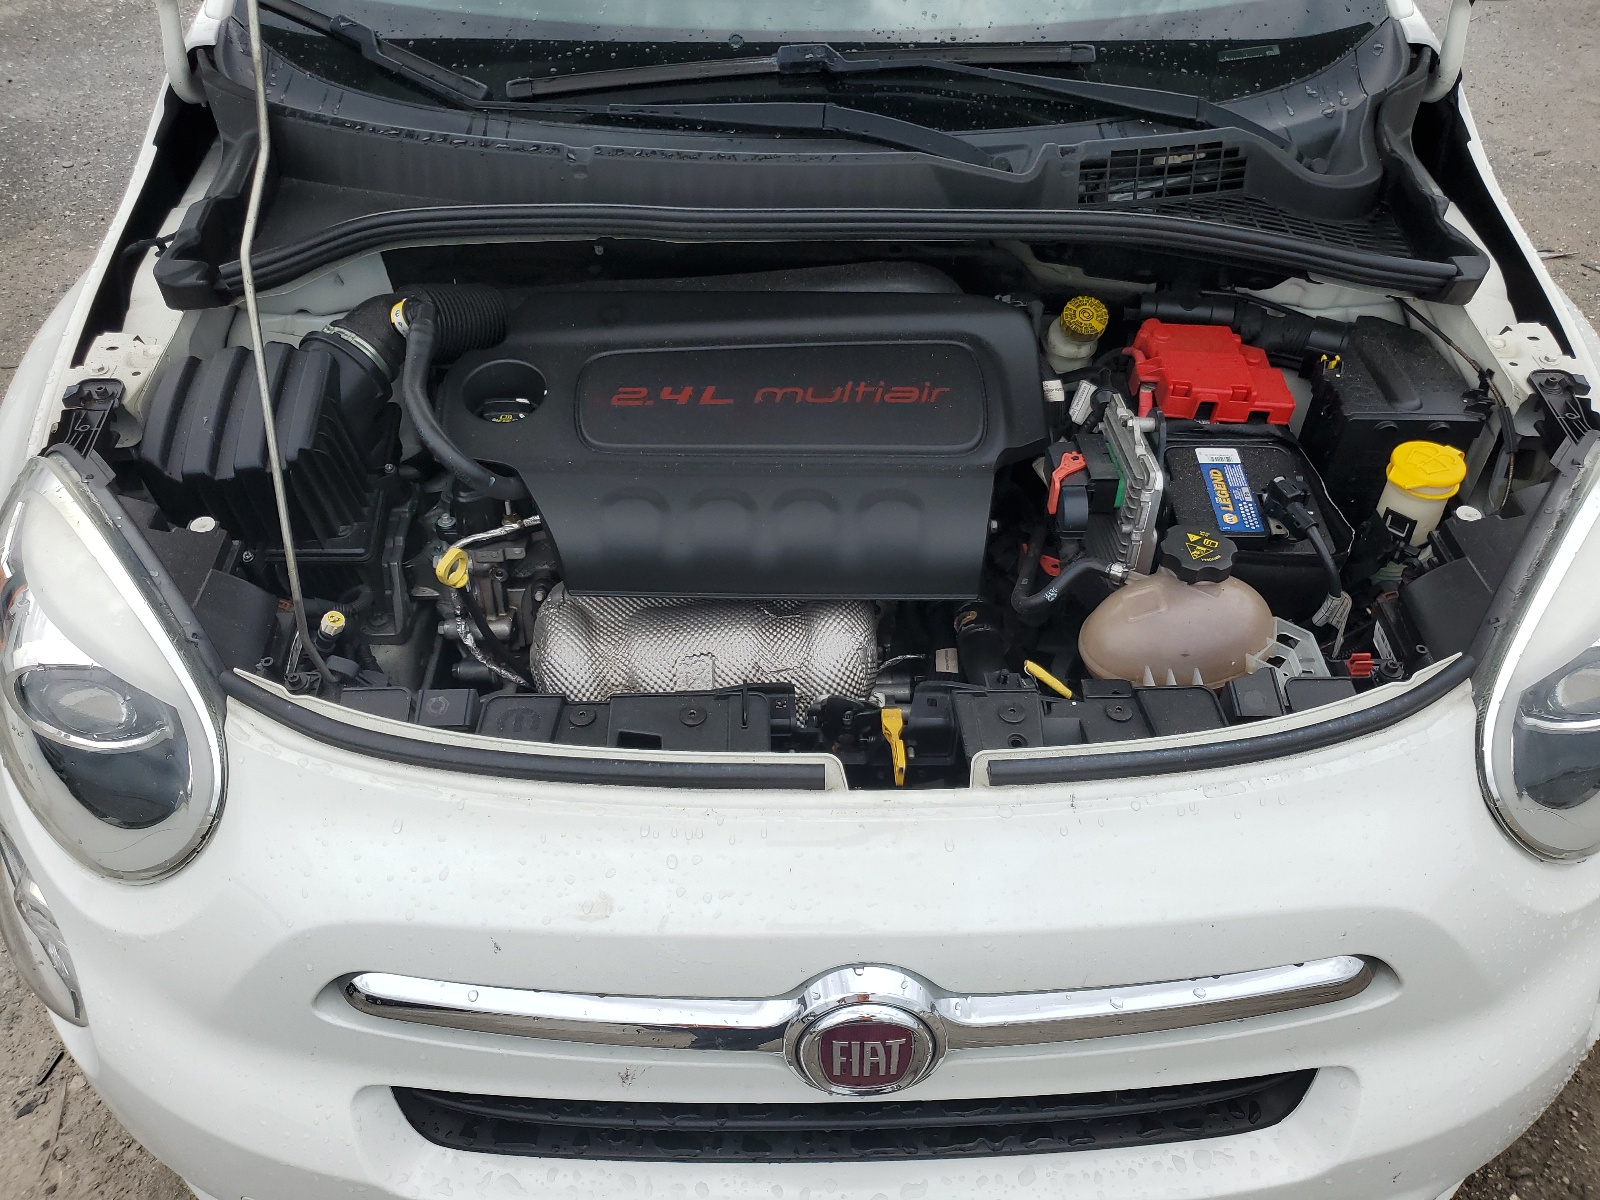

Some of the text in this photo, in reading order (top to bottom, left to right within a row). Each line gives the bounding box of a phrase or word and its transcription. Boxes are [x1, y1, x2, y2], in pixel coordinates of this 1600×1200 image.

[610, 380, 951, 406] 2.4L multiair
[1209, 468, 1235, 512] LEGEND
[831, 1038, 907, 1077] FIAT
